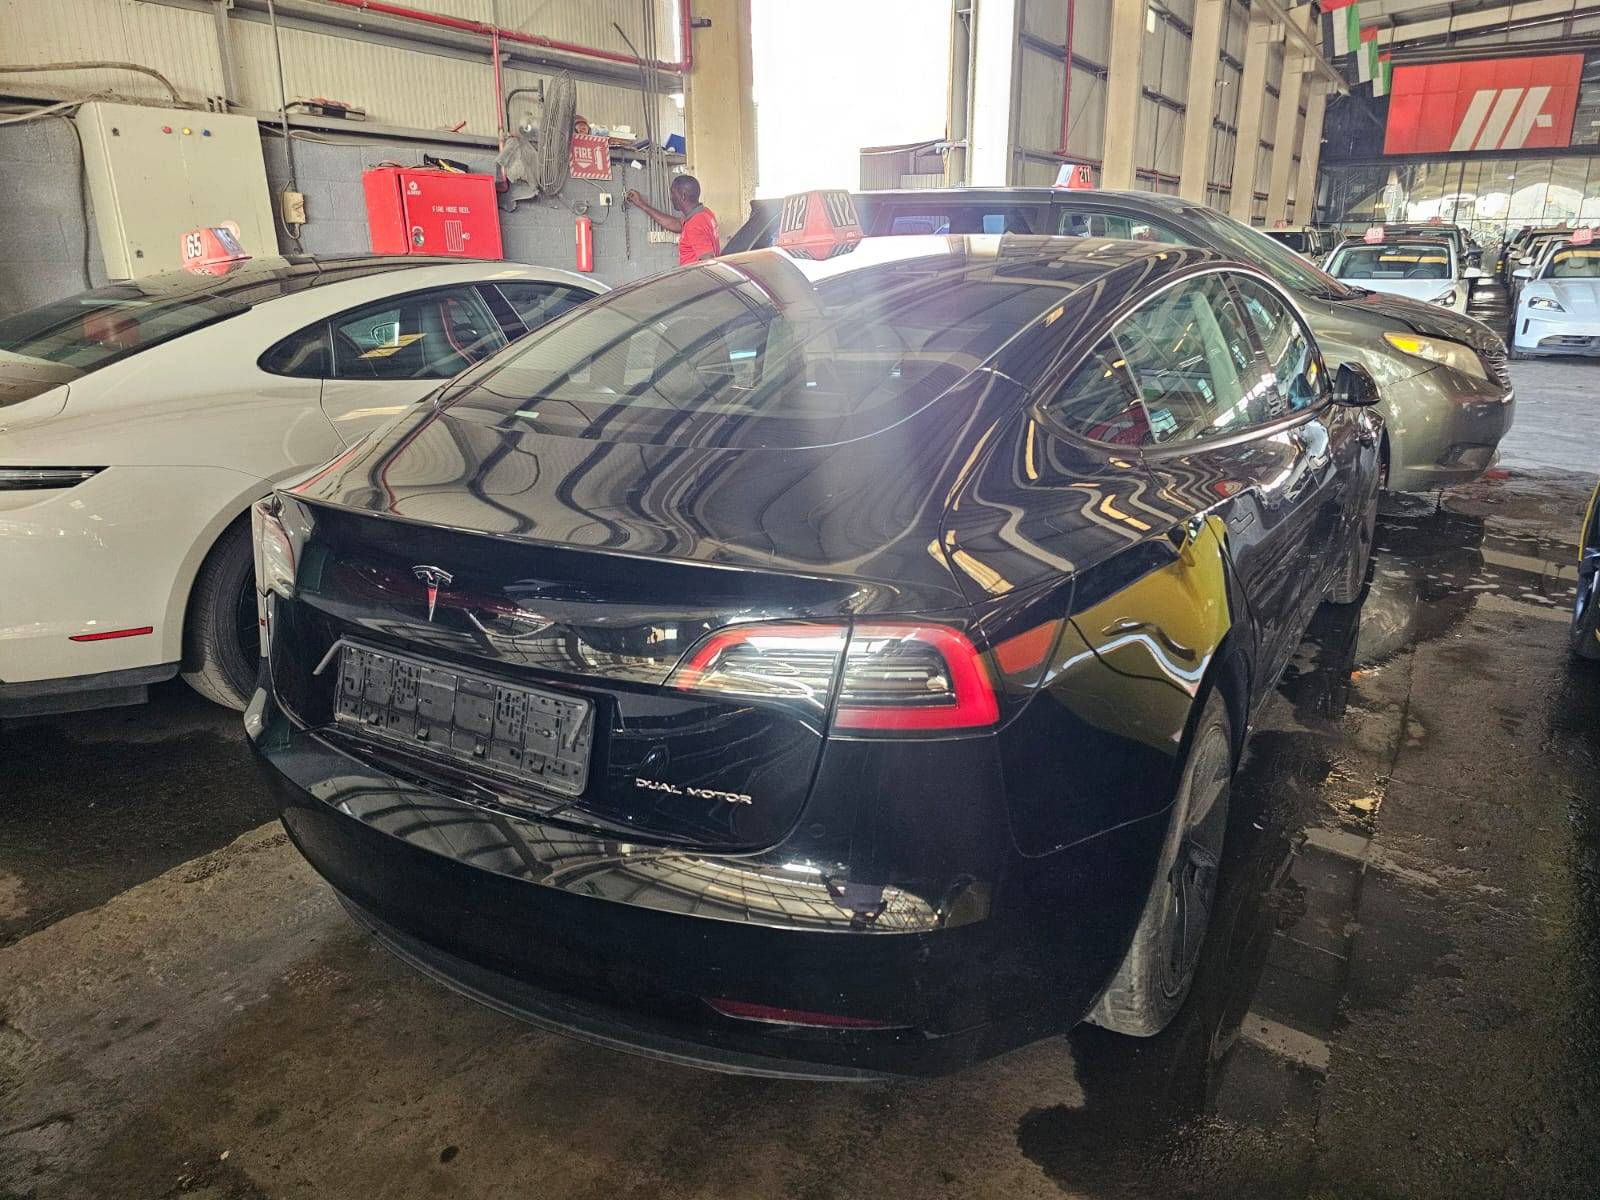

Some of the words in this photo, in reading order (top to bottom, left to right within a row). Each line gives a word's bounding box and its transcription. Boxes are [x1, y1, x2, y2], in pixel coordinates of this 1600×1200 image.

[574, 147, 592, 159] FIRE
[1079, 165, 1090, 183] 211
[432, 205, 444, 213] FIRE
[459, 206, 470, 214] REEL
[784, 195, 807, 232] 112
[825, 191, 856, 227] 112
[186, 232, 202, 259] 65
[635, 778, 682, 795] DUAL
[687, 787, 752, 804] MOTOR
